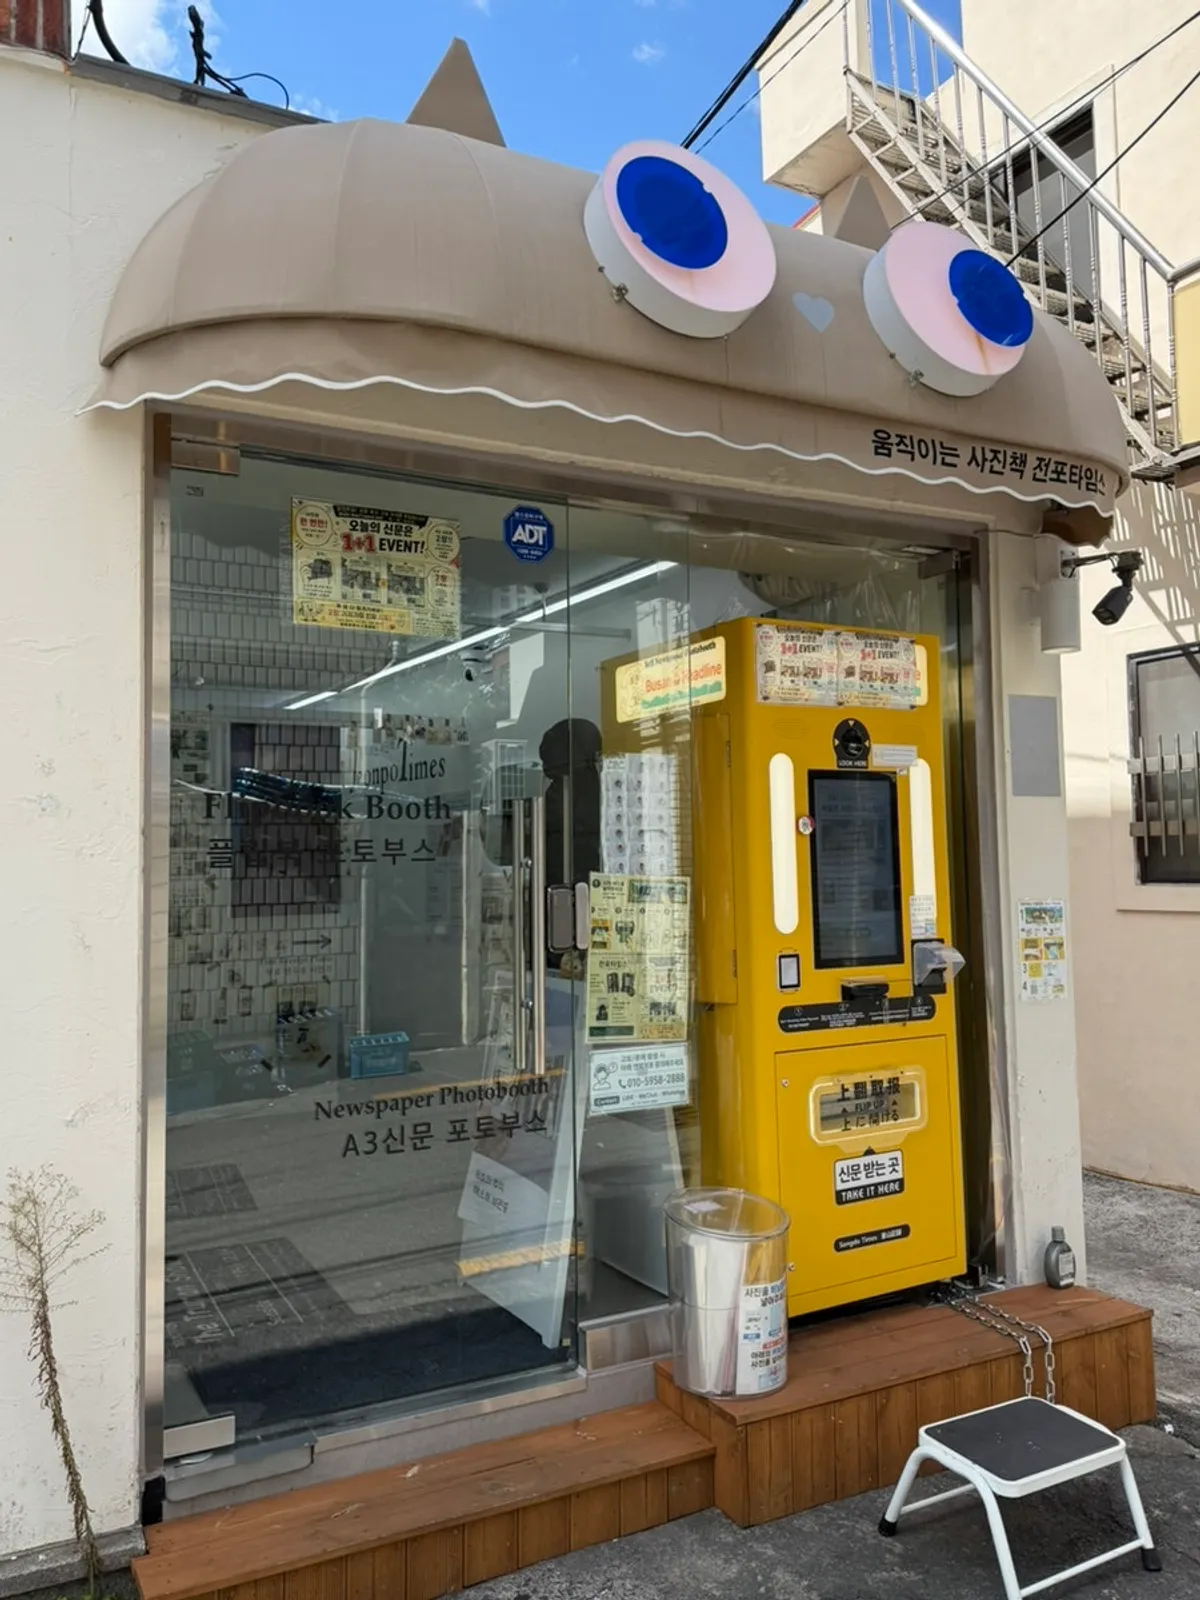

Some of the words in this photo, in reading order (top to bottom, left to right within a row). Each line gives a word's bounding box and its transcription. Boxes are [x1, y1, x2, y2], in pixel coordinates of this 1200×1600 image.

[872, 428, 961, 468] 움직이는
[967, 445, 1027, 480] 사진책
[1032, 456, 1106, 496] 전포타임스
[349, 519, 380, 533] 오늘의
[384, 523, 413, 538] 신문은
[512, 524, 547, 545] ADT
[341, 532, 377, 554] 1+1
[379, 538, 425, 554] EVENT!
[367, 795, 451, 819] Booth
[314, 1094, 434, 1120] Newspaper
[440, 1077, 549, 1105] Photobooth
[342, 1121, 434, 1158] A3신문
[446, 1110, 547, 1143] 포토부스
[838, 1163, 862, 1183] 신문
[863, 1160, 887, 1179] 받는
[888, 1157, 900, 1175] 곳
[841, 1188, 865, 1202] TAKE
[866, 1186, 875, 1197] IT
[877, 1181, 900, 1195] HERE
